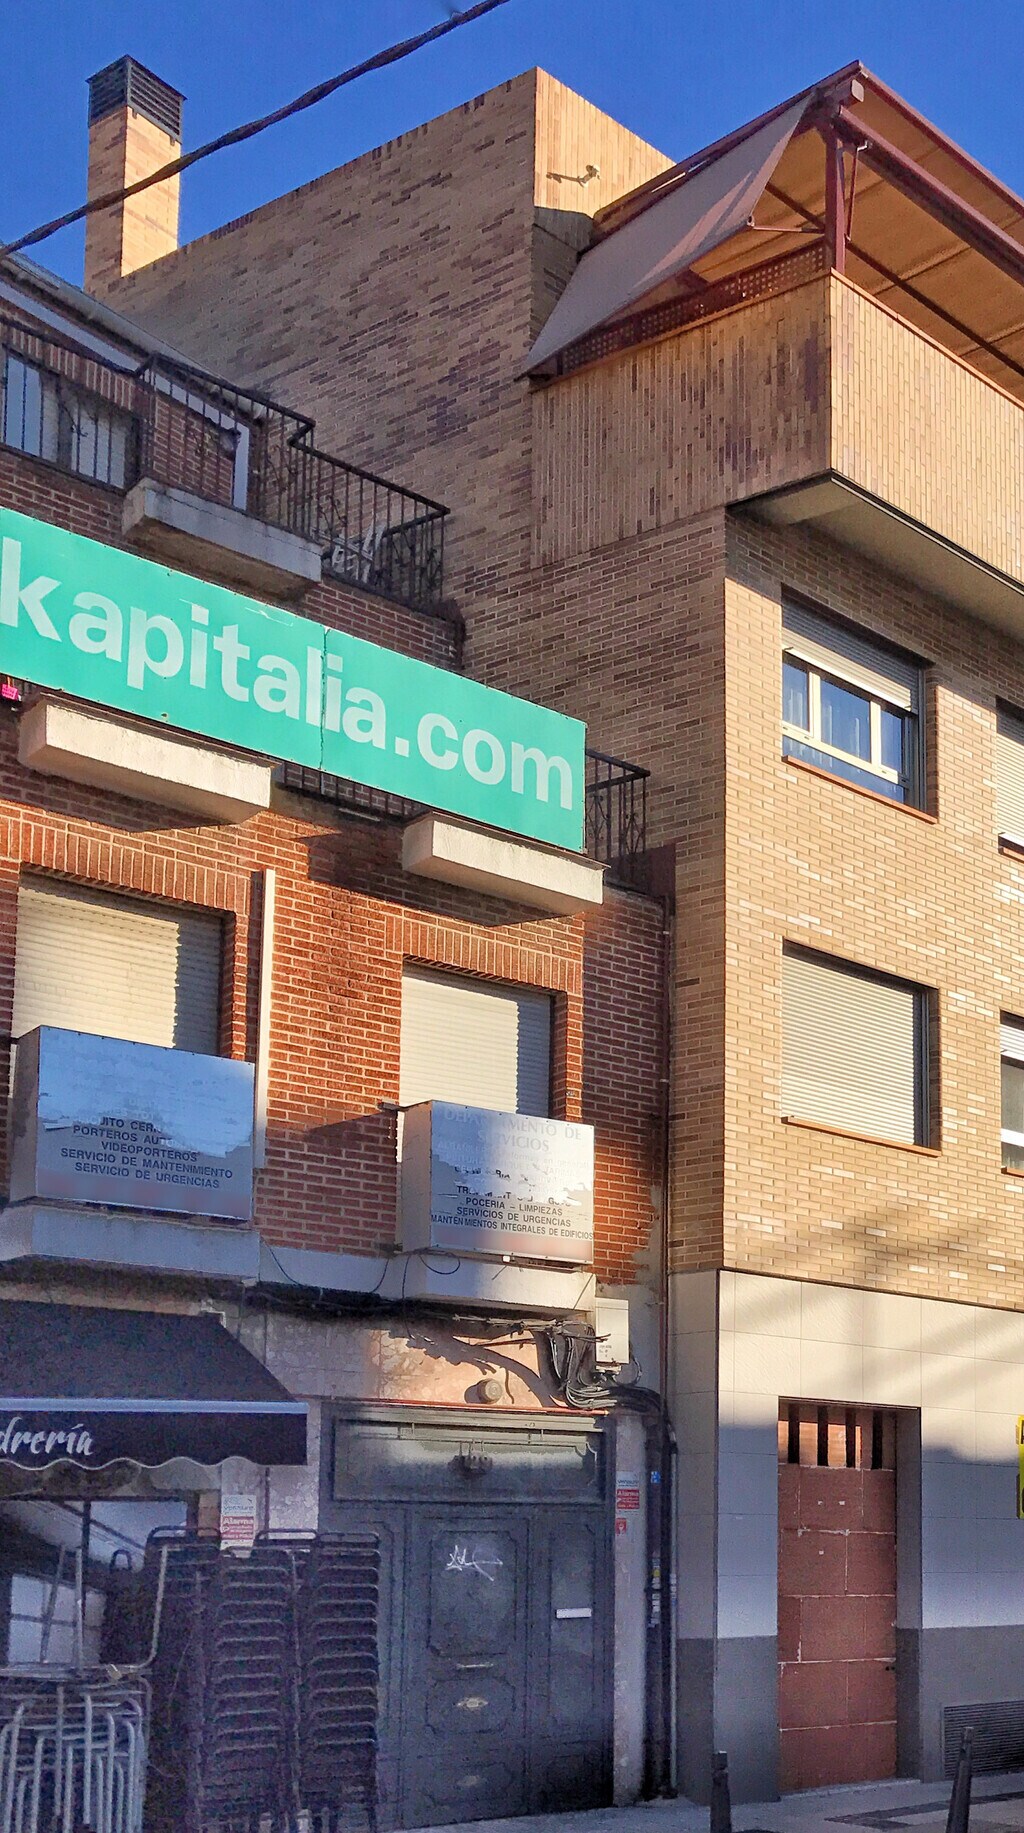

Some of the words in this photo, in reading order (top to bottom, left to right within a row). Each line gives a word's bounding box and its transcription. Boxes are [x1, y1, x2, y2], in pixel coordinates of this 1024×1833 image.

[0, 536, 573, 812] kapitalia.com
[73, 1125, 138, 1142] PORTEROS
[101, 1141, 198, 1162] VIDEOPORTEROS
[61, 1148, 116, 1163] SERVICIO
[122, 1156, 137, 1167] DE
[142, 1159, 233, 1179] MANTENIMIENTO
[75, 1162, 130, 1177] SERVICIO
[136, 1169, 150, 1180] DE
[156, 1172, 220, 1189] URGENCIAS
[465, 1197, 505, 1210] POCERIA
[519, 1204, 563, 1216] LIMPIEZAS
[456, 1207, 504, 1221] SERVICIOS
[507, 1213, 519, 1222] DE
[523, 1215, 572, 1228] URGENCIAS
[500, 1222, 546, 1235] INTEGRALES
[548, 1228, 558, 1237] DE
[560, 1229, 593, 1240] EDIFICIOS
